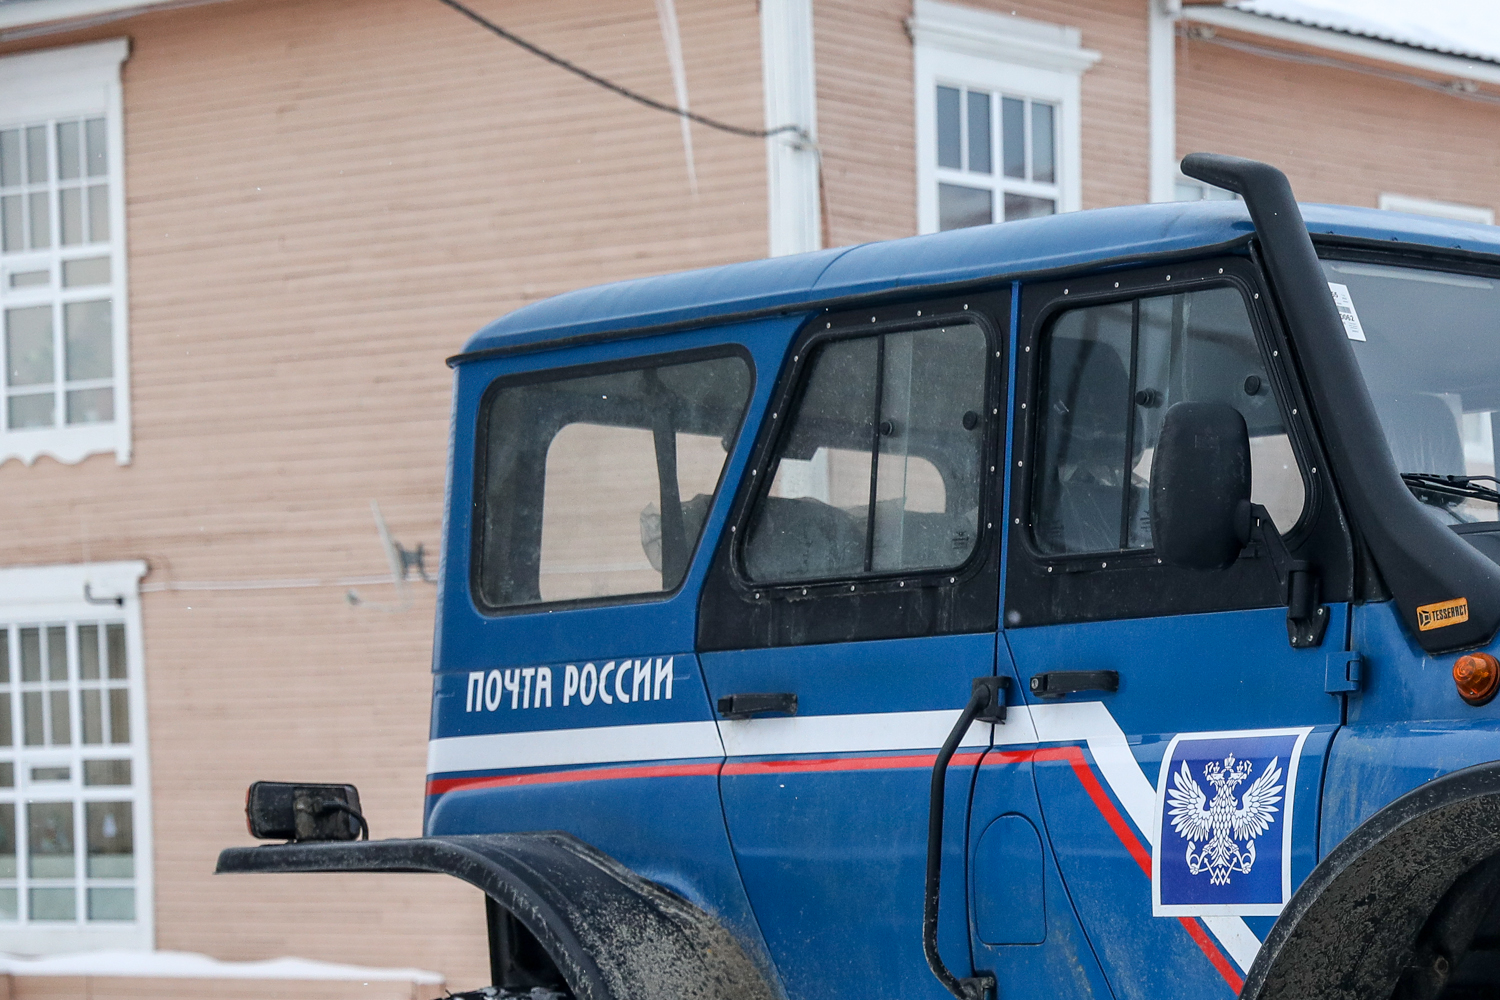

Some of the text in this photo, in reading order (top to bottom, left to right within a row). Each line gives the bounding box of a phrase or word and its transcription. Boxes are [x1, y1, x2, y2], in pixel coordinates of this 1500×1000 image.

[1432, 604, 1467, 621] TESSERACT
[466, 656, 674, 712] ПОЧТА РОССИИ
